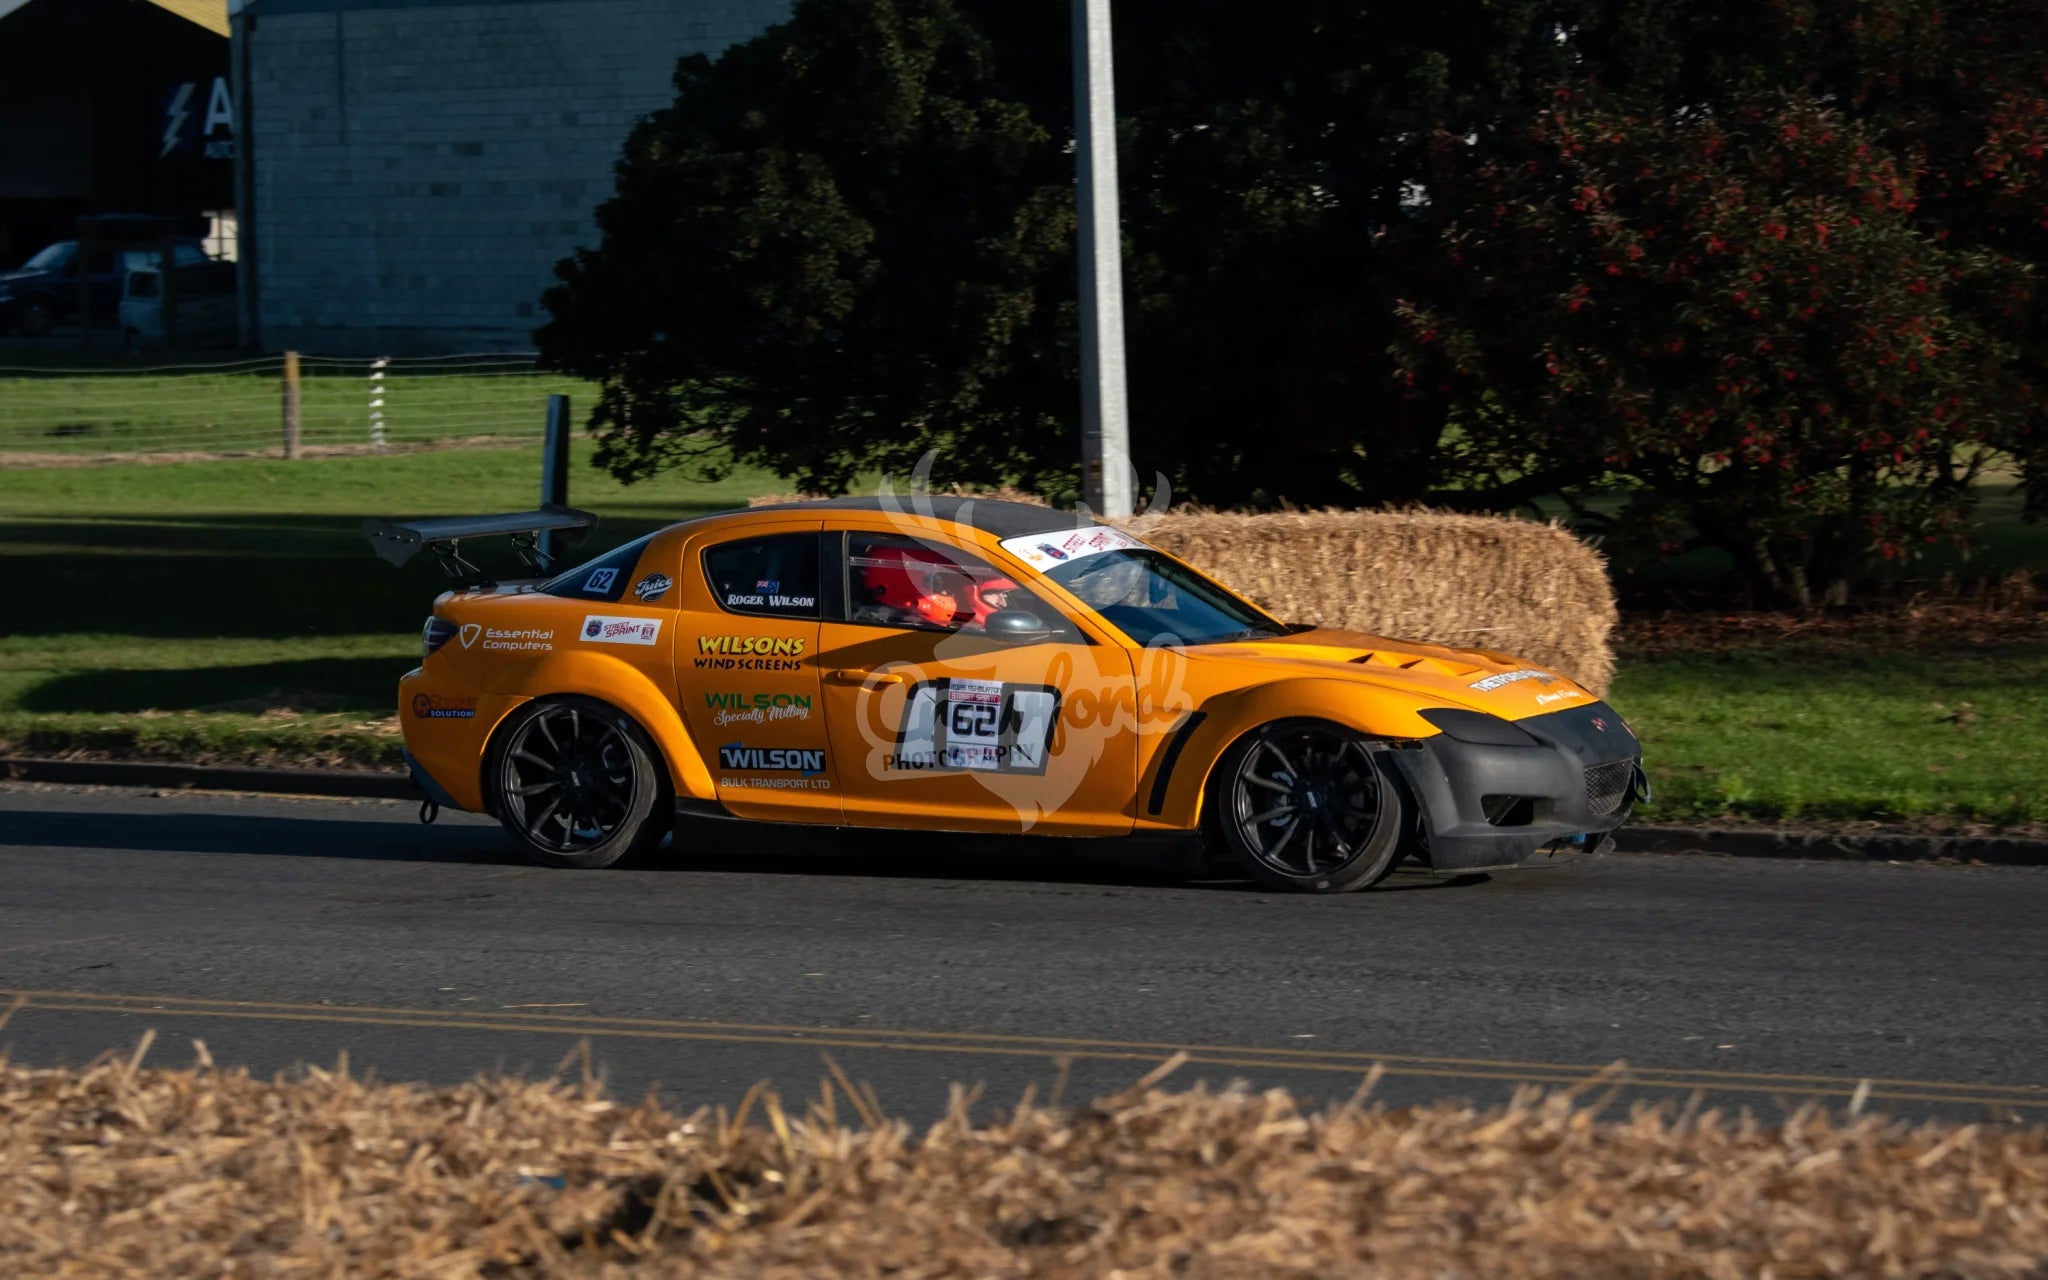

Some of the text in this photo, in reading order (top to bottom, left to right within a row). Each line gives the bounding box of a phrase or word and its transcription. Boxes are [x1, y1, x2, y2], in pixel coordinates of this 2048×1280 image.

[589, 571, 613, 589] 62
[603, 621, 630, 631] STREET
[605, 625, 640, 638] SPRINT
[486, 628, 554, 640] Essential
[482, 640, 553, 651] Computers
[698, 635, 805, 657] WILSONS
[694, 658, 801, 671] WINDSCREENS
[705, 692, 812, 710] WILSON
[713, 704, 809, 728] Specialty Milling
[952, 703, 997, 737] 62
[720, 748, 825, 771] WILSON
[721, 777, 831, 790] BULK TRANSPORT LTD
